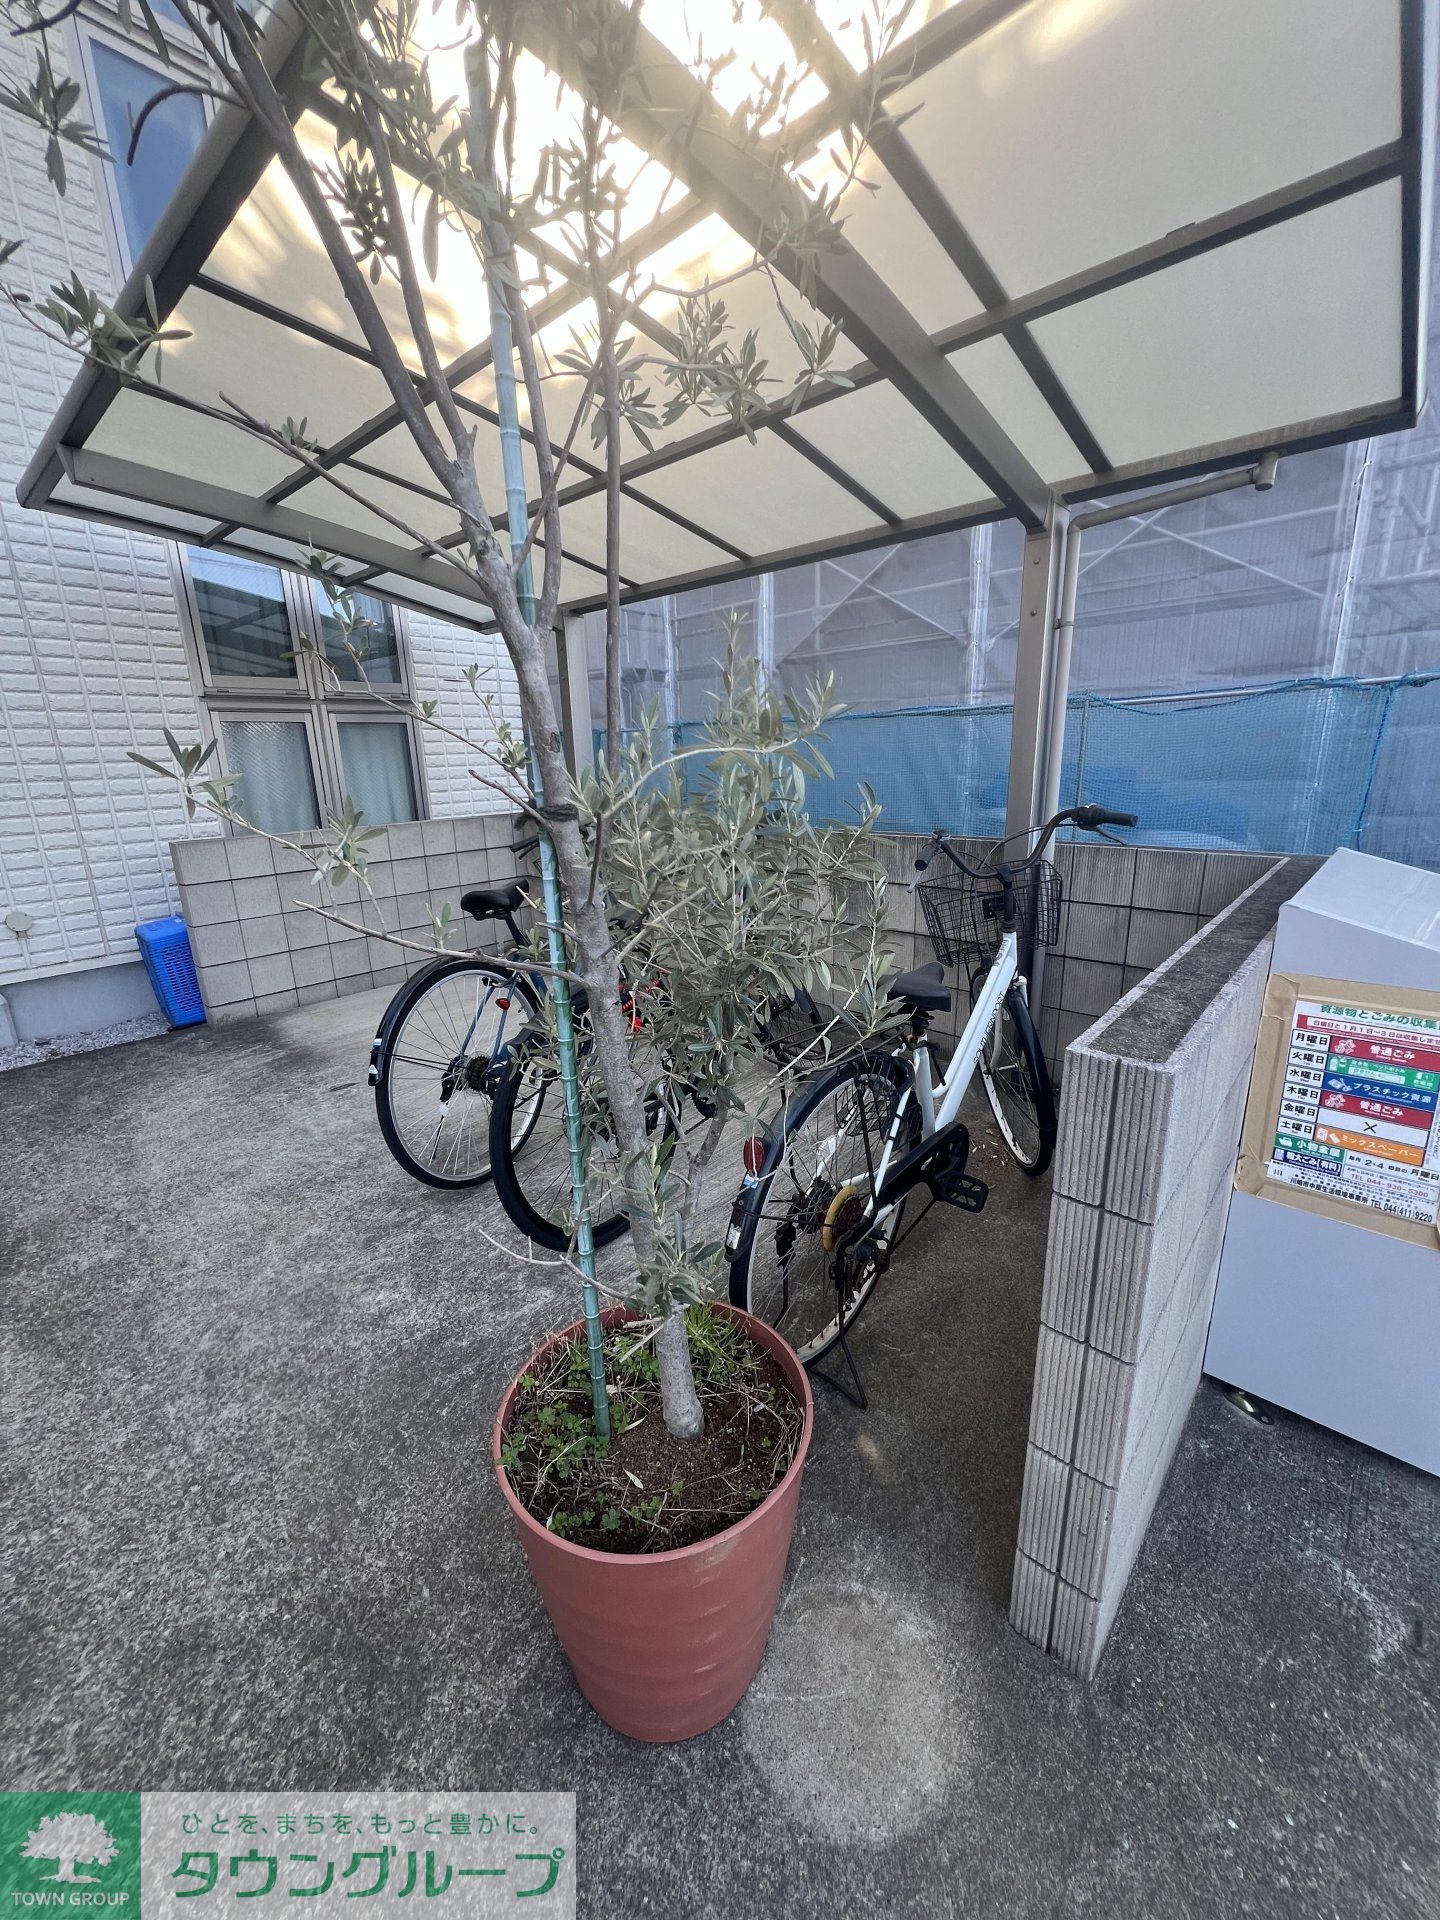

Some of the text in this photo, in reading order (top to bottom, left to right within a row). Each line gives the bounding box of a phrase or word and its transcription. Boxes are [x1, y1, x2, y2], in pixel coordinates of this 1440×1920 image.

[1320, 1003, 1440, 1031] 資源物とごみの収集
[1295, 1032, 1328, 1045] 月曜日
[1292, 1051, 1325, 1064] 火曜日
[1370, 1044, 1415, 1060] 普通ごみ
[1289, 1068, 1322, 1082] 水曜日
[1286, 1085, 1319, 1099] 木曜日
[1353, 1082, 1432, 1103] プラスチック資源
[1284, 1103, 1315, 1116] 金曜日
[1360, 1100, 1403, 1116] 普通ごみ
[1281, 1120, 1312, 1133] 土曜日
[1341, 1134, 1419, 1157] ミックスペーパー
[1351, 1173, 1363, 1181] TEL
[1370, 1199, 1382, 1209] TEL
